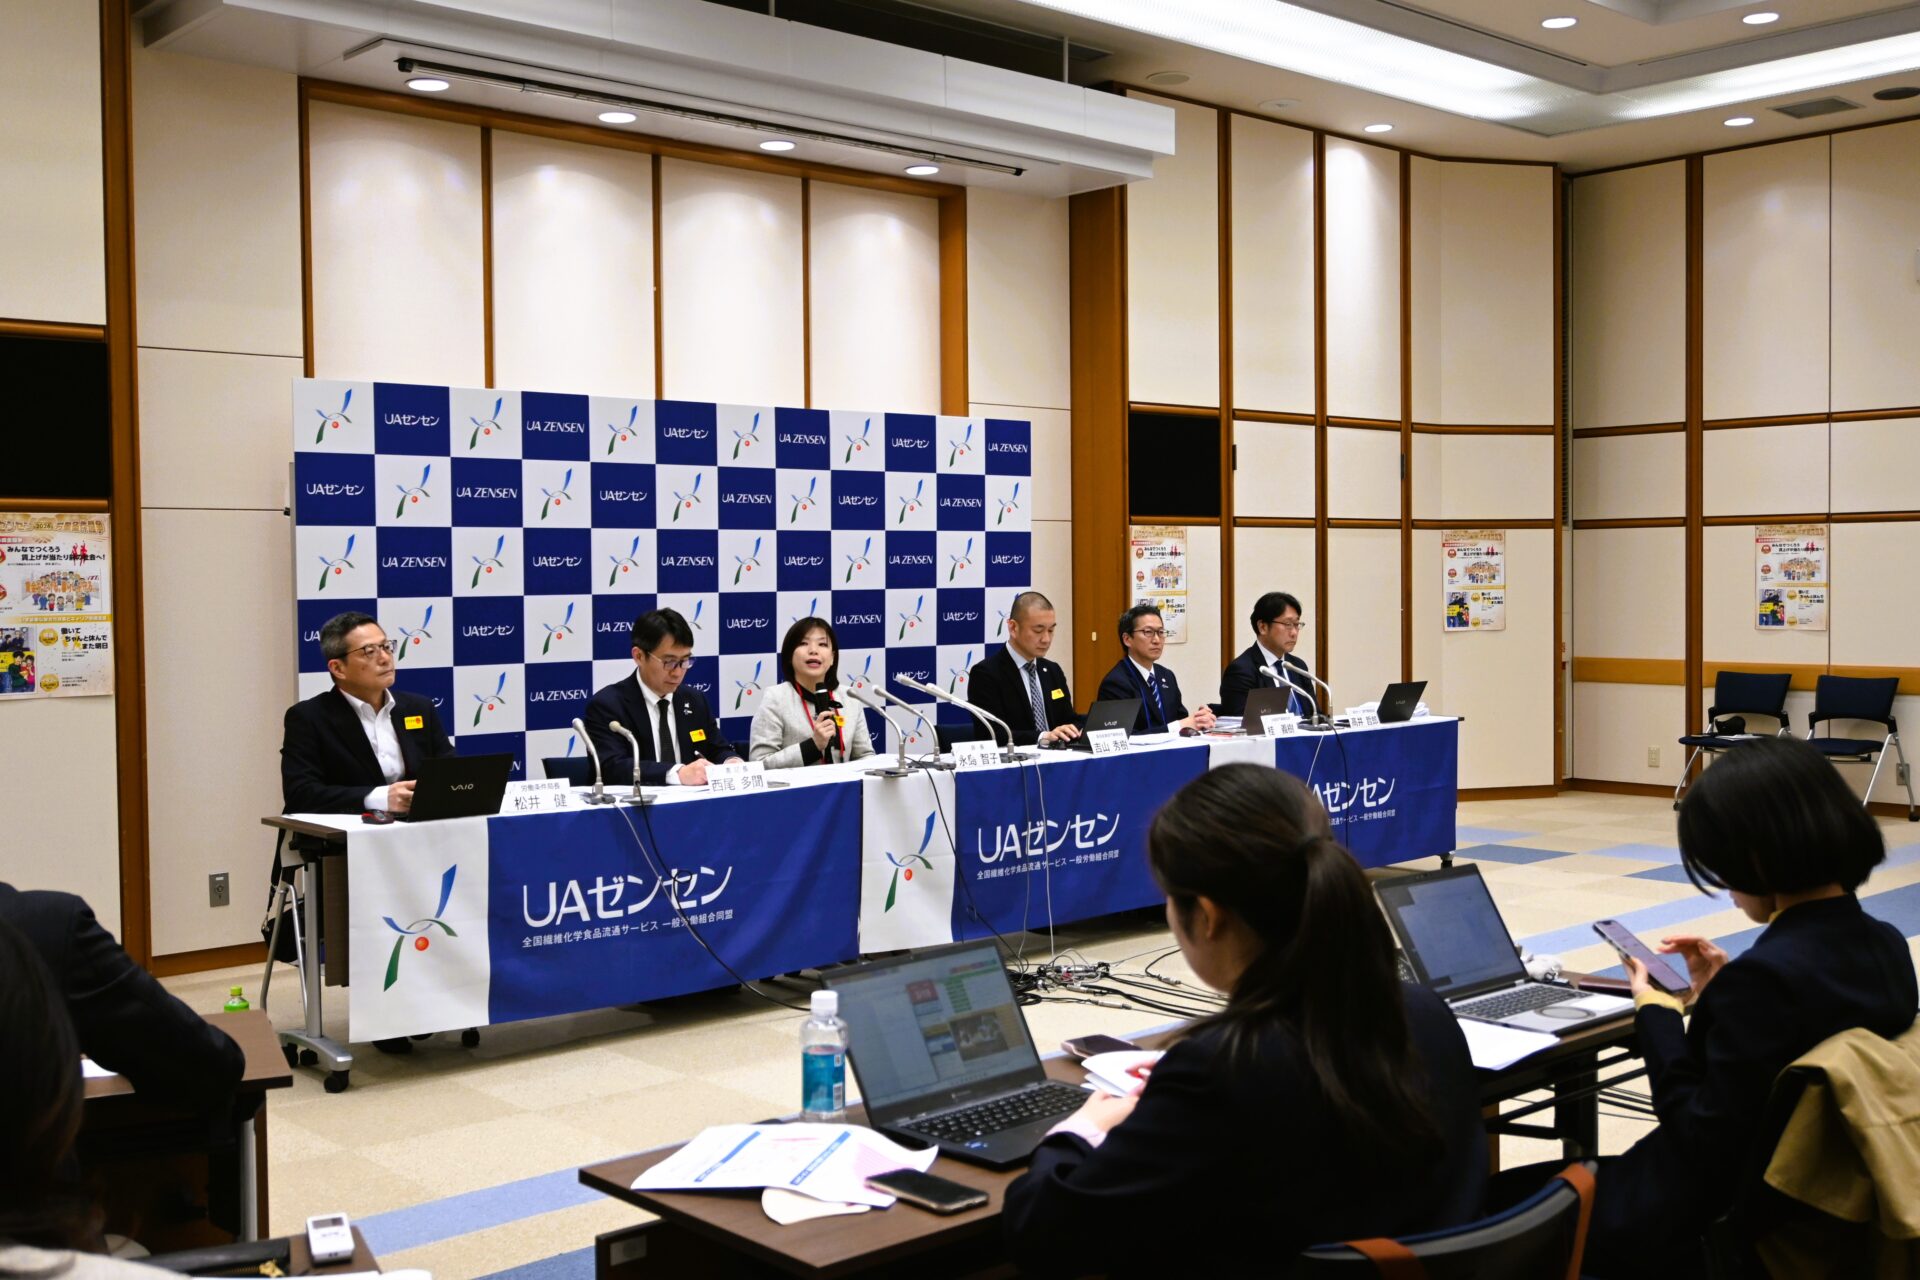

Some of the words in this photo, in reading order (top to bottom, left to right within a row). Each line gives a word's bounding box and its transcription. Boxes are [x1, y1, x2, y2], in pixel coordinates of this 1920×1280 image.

[384, 413, 440, 427] UAゼンセン
[526, 420, 542, 432] UA
[542, 420, 585, 433] ZENSEN
[663, 427, 709, 439] UAゼンセン
[778, 433, 792, 444] UA
[792, 433, 826, 445] ZENSEN
[891, 437, 930, 449] UAゼンセン
[988, 442, 999, 452] UA
[999, 442, 1028, 453] ZENSEN
[306, 483, 365, 496] UAゼンセン
[456, 487, 472, 498] UA
[473, 487, 518, 499] ZENSEN
[599, 490, 648, 502] UAゼンセン
[721, 493, 735, 503] UA
[736, 493, 772, 504] ZENSEN
[838, 495, 878, 506] UAゼンセン
[939, 497, 951, 507] UA
[951, 497, 982, 508] ZENSEN
[382, 556, 399, 567] UA
[400, 556, 447, 568] ZENSEN
[532, 556, 582, 567] UAゼンセン
[661, 556, 675, 566] UA
[676, 556, 714, 567] ZENSEN
[784, 555, 824, 566] UAゼンセン
[888, 555, 901, 564] UA
[901, 555, 933, 565] ZENSEN
[991, 554, 1025, 564] UAゼンセン
[835, 614, 848, 624] UA
[848, 614, 882, 625] ZENSEN
[943, 611, 979, 622] UAゼンセン
[596, 622, 611, 632] UA
[612, 621, 635, 632] ZEN
[726, 618, 769, 629] UAゼンセン
[462, 624, 515, 637] UAゼンセン
[529, 689, 545, 701] UA
[546, 689, 588, 702] ZENSEN
[450, 783, 475, 791] VAIO
[1312, 776, 1396, 813] Aゼンセン
[977, 813, 1120, 864] UAゼンセン
[522, 866, 733, 928] UAゼンセン
